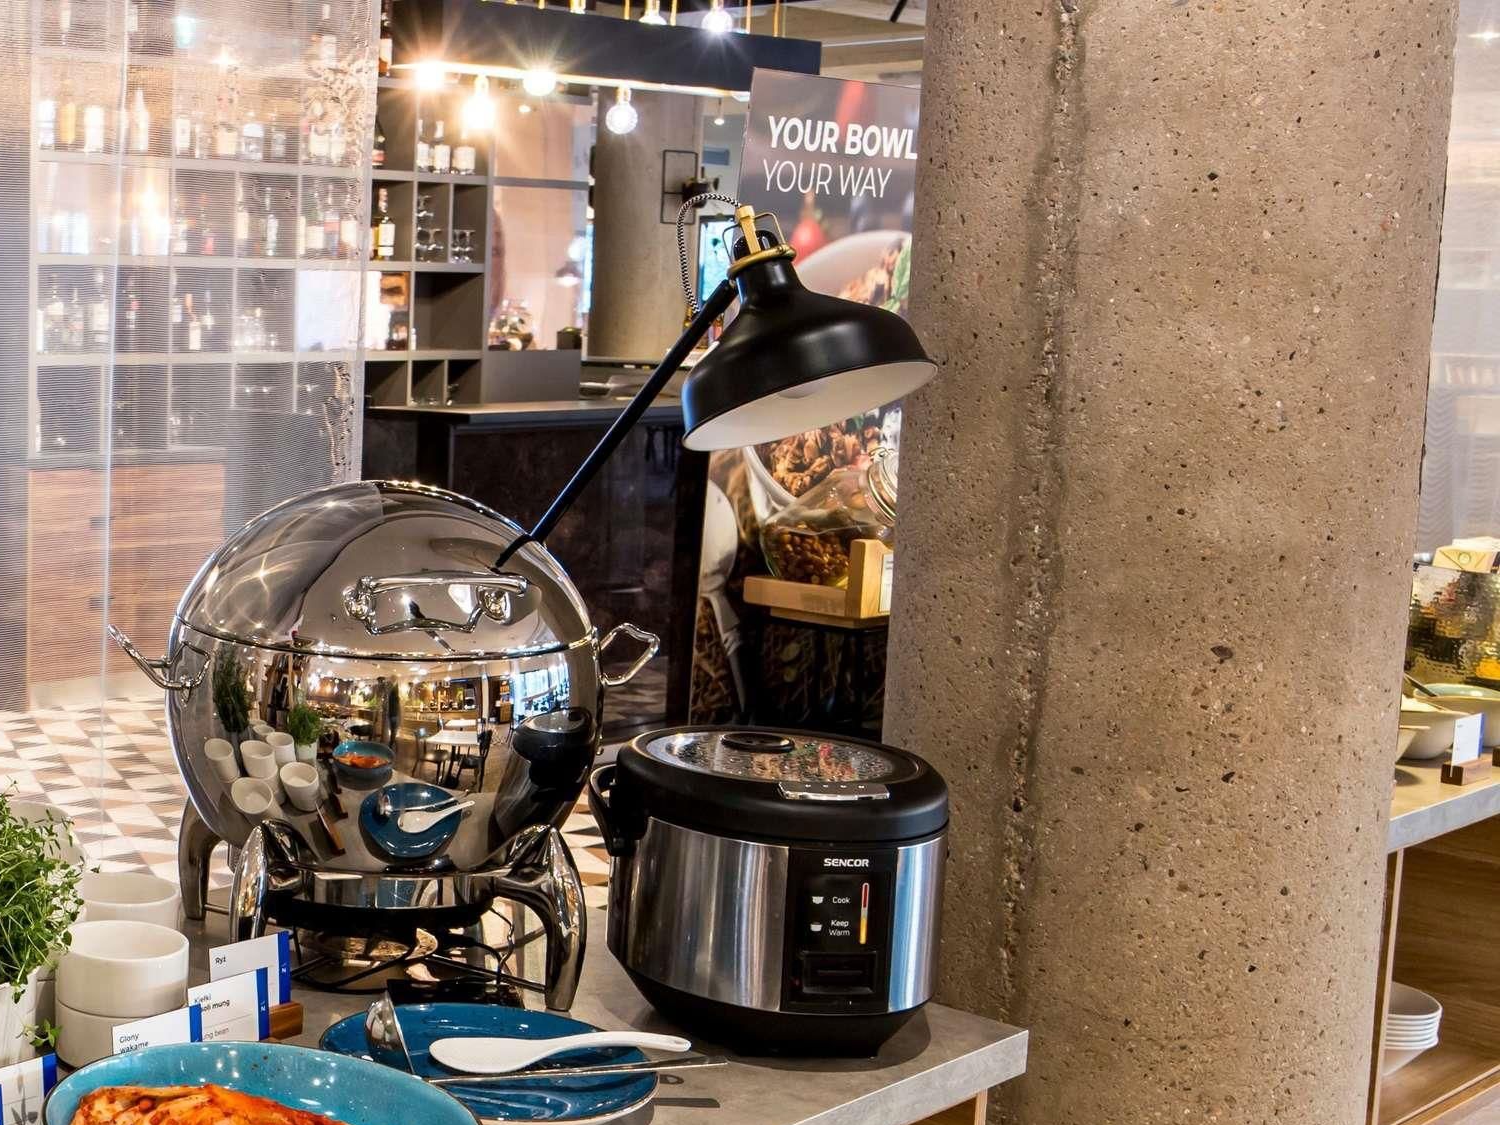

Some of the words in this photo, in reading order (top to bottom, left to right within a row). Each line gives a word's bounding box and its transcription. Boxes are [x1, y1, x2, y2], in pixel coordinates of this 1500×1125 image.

[768, 115, 840, 154] YOUR
[843, 122, 919, 160] BOWL
[762, 159, 832, 196] YOUR
[837, 165, 893, 199] WAY
[823, 858, 870, 867] SENCOR
[832, 896, 851, 904] Cook
